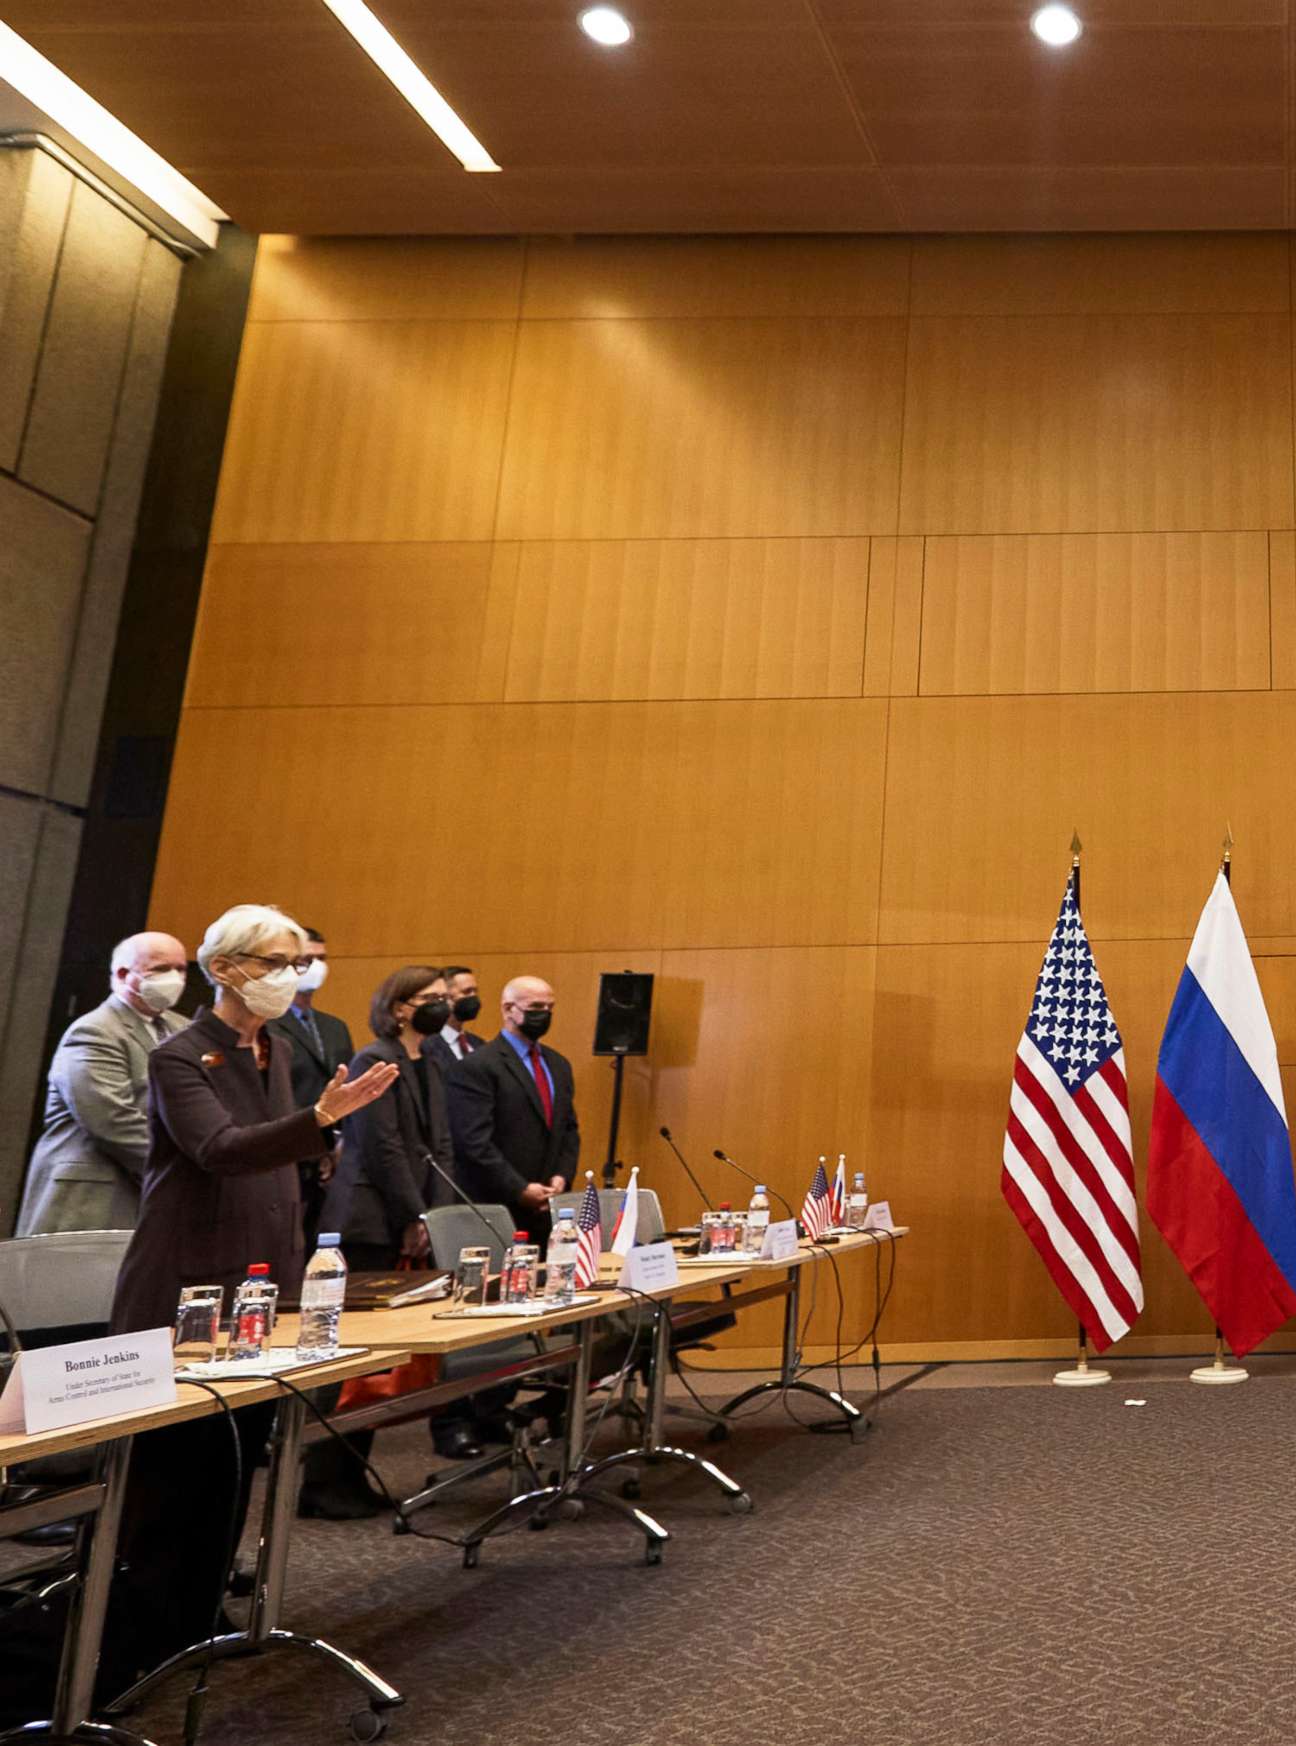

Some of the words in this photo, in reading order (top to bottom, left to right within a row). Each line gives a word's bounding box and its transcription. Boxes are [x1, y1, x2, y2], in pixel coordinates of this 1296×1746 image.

[65, 1357, 101, 1373] Bonnie
[103, 1351, 140, 1365] Jenkins
[84, 1377, 110, 1388] Secretary
[65, 1391, 87, 1401] Control
